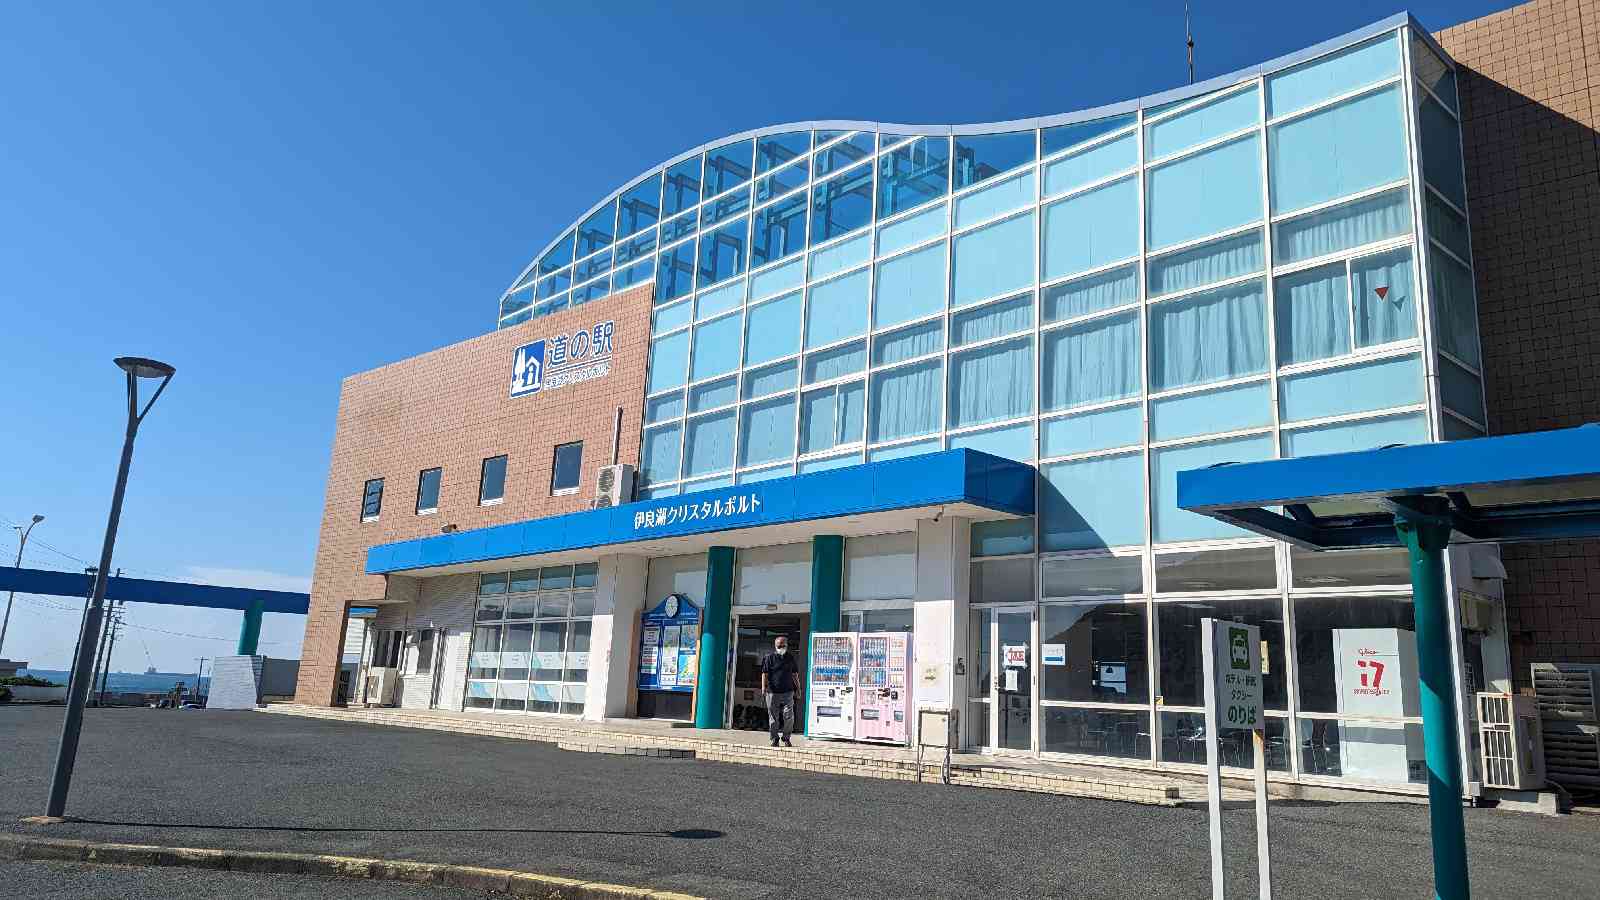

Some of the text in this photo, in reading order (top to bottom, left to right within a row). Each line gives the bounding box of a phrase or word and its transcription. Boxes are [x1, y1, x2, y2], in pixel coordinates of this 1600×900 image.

[547, 321, 614, 368] 道の駅
[634, 493, 761, 530] 伊良湖クリスタルポルト
[1227, 704, 1257, 725] のりば
